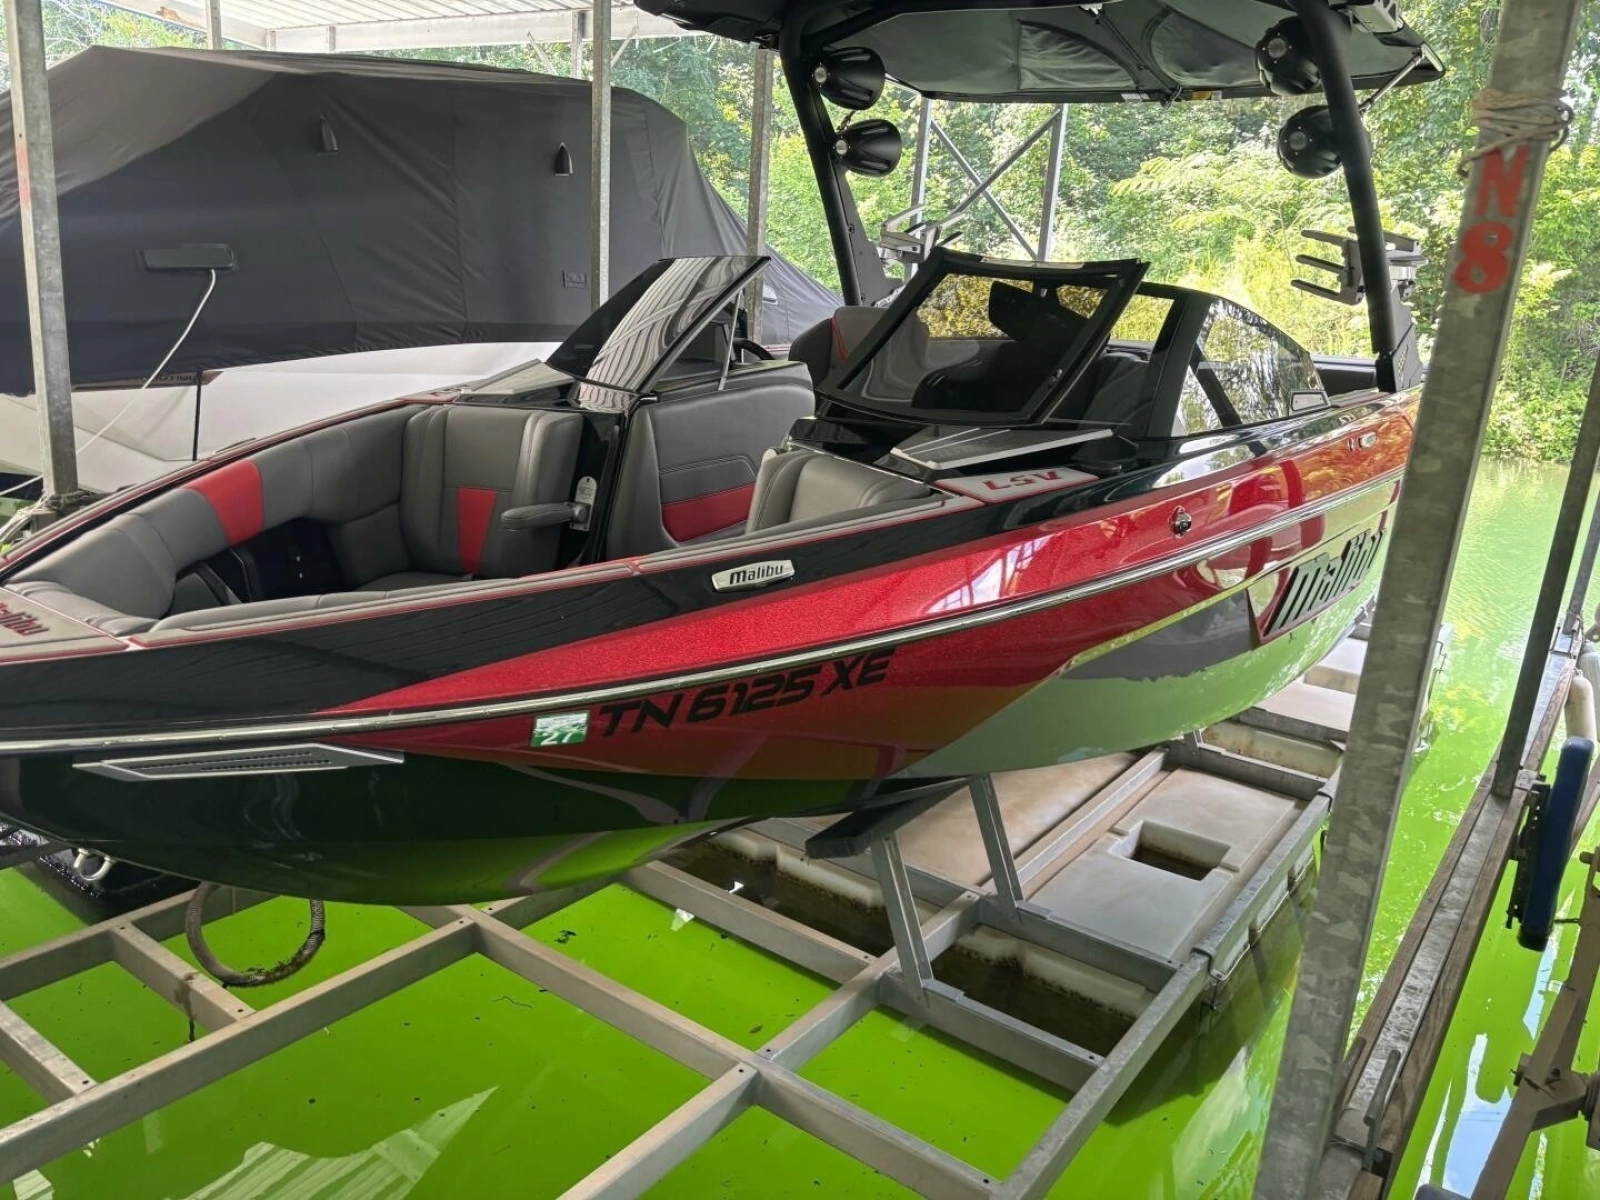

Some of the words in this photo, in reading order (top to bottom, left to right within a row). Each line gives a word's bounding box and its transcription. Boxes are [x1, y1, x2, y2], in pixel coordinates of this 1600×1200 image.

[982, 471, 1063, 491] LSV
[729, 564, 784, 585] Malibu
[599, 693, 684, 737] TN
[688, 666, 822, 722] 6125
[820, 645, 897, 696] XE
